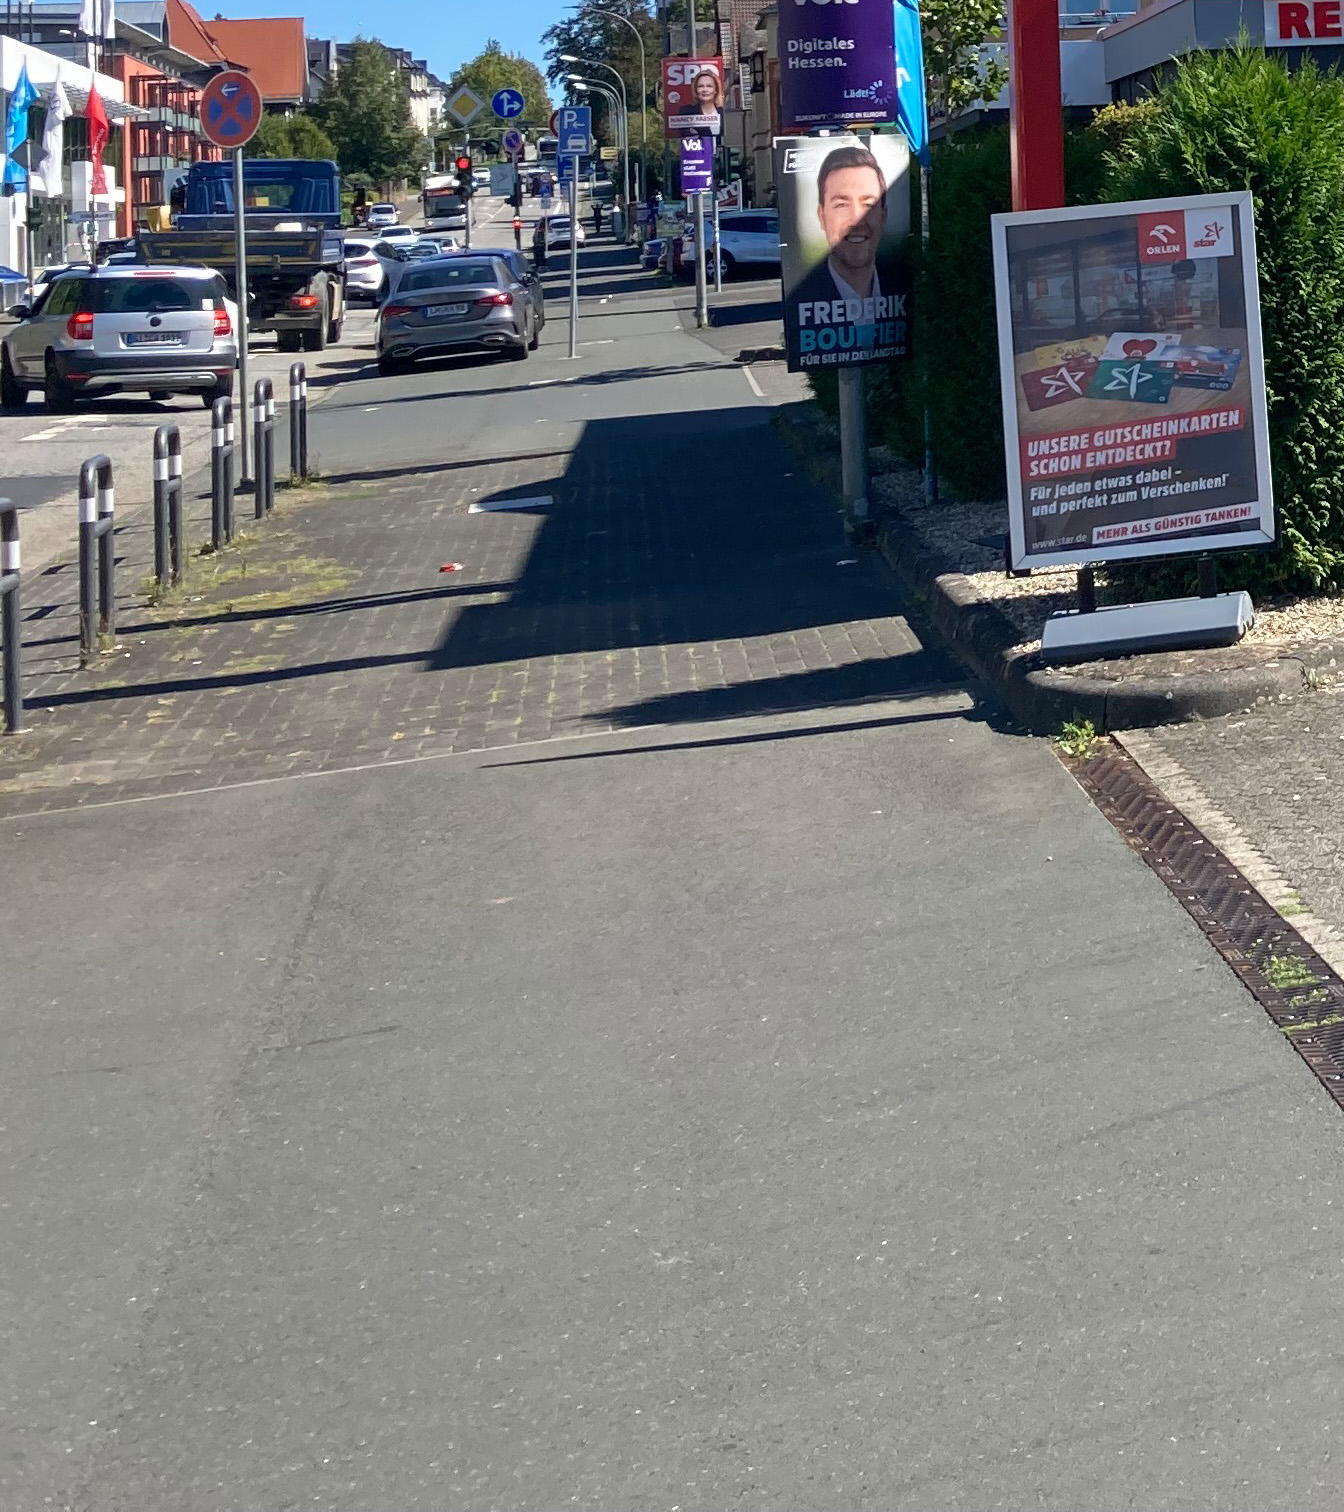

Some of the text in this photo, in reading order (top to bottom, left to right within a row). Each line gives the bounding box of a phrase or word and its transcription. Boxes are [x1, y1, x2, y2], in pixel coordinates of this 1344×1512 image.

[787, 37, 855, 54] Digitales
[788, 57, 847, 69] Hessen.
[564, 110, 577, 129] P
[1146, 238, 1217, 255] ORLEN star
[798, 294, 907, 326] FREDERIK
[800, 346, 906, 366] FÜR SIE IN DEN LANDTAG
[1027, 409, 1240, 457] UNSERE GUTSCHEINKARTEN
[1029, 440, 1172, 476] SCHON ENTDECKT?
[1030, 485, 1051, 501] Für
[1054, 482, 1091, 500] jeden
[1094, 476, 1133, 491] etwas
[1135, 468, 1172, 484] dabei
[1031, 502, 1057, 517] und
[1059, 493, 1108, 515] perfekt
[1110, 491, 1137, 505] zum
[1096, 506, 1252, 541] MEHR ALS GÜNSTIG TANKEN!
[1031, 533, 1088, 550] www.star.de
